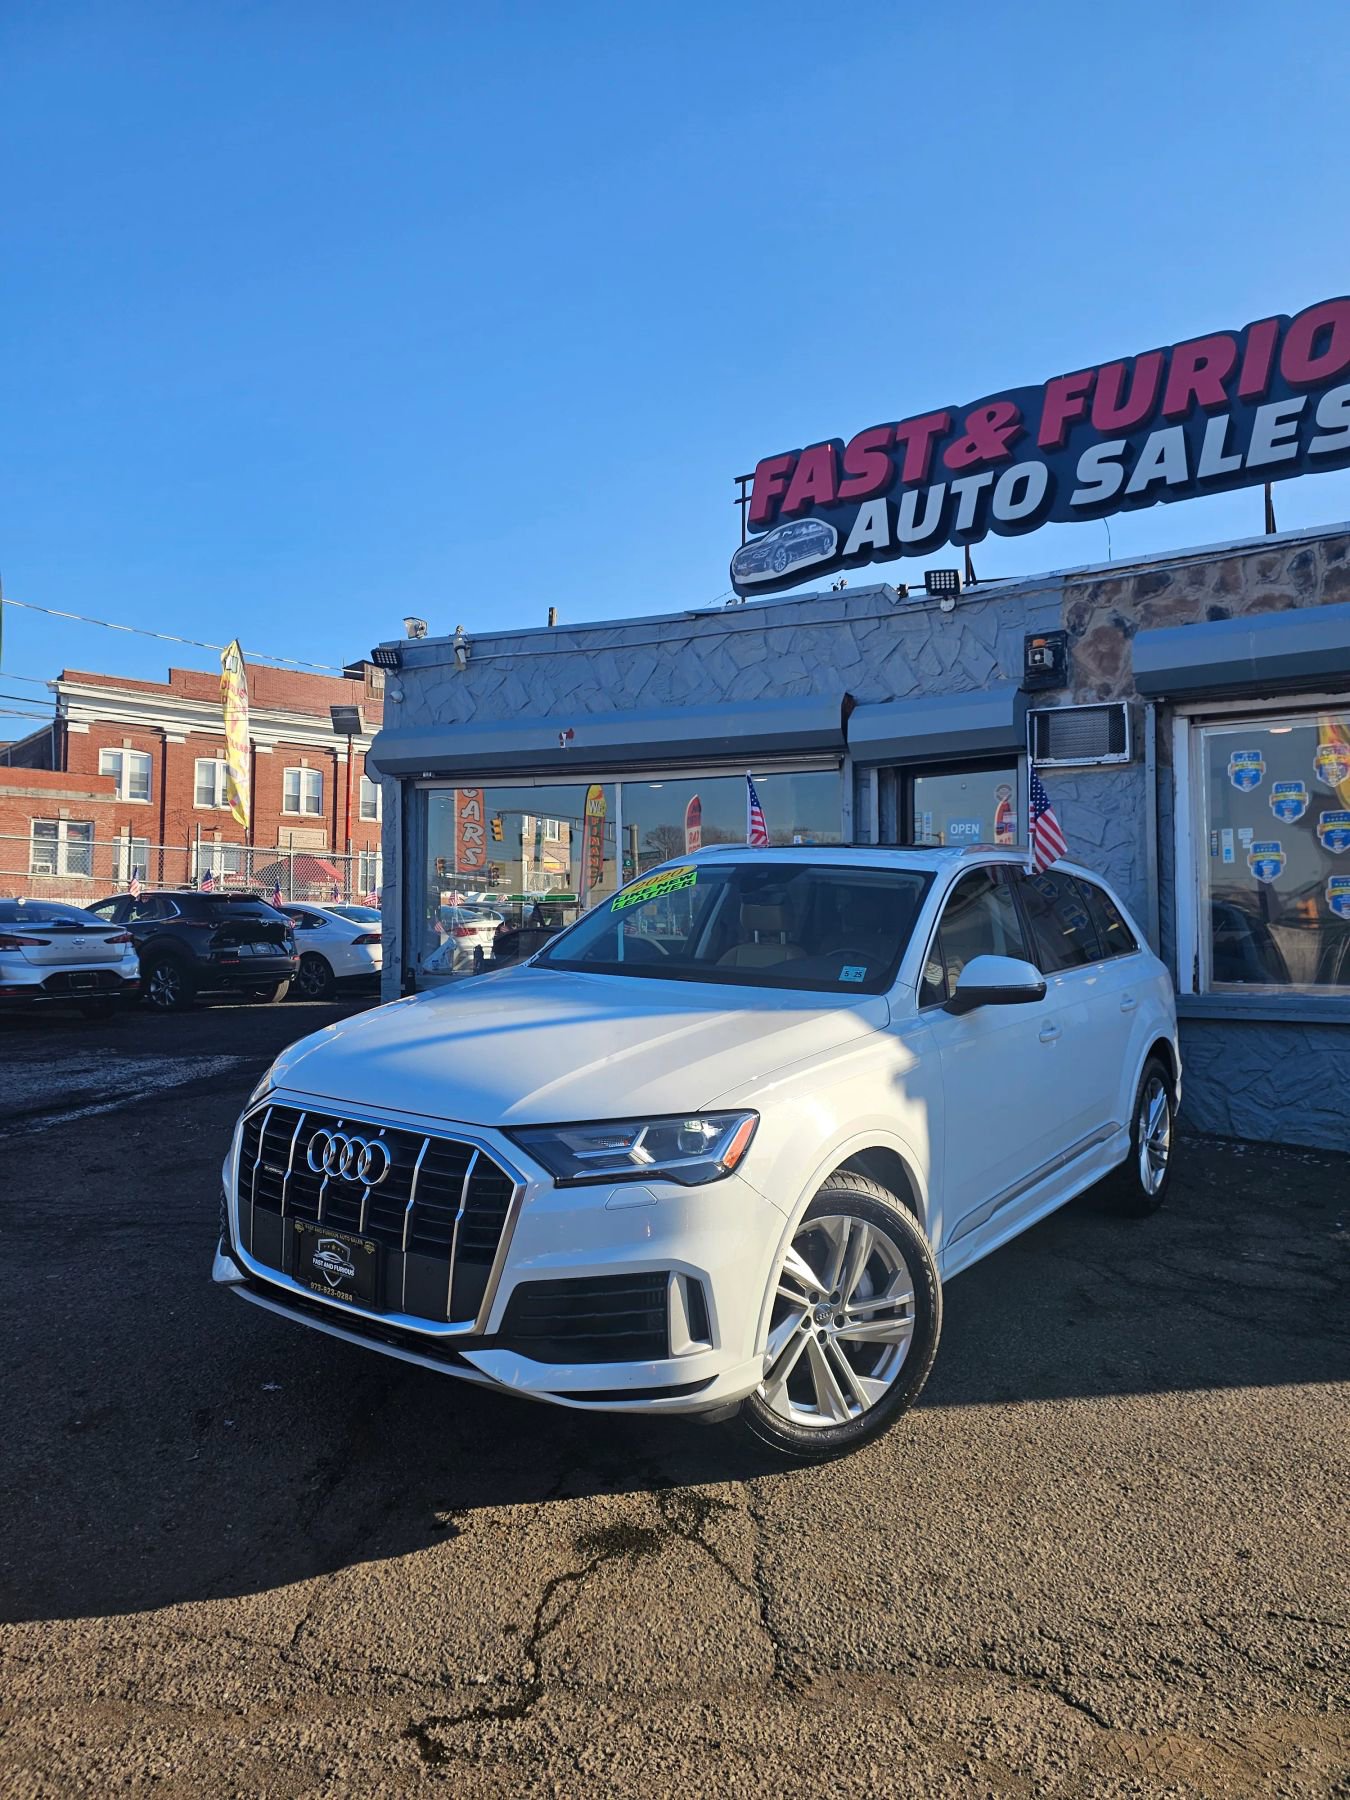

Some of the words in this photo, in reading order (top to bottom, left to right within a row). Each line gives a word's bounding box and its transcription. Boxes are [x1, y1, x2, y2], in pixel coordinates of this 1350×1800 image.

[748, 412, 951, 524] FAST
[943, 402, 1024, 470] &
[1038, 297, 1350, 449] FURIO
[842, 460, 1049, 555] AUTO
[1069, 383, 1350, 508] SALES
[950, 823, 980, 835] OPEN
[612, 879, 694, 911] LEATHER
[614, 886, 652, 904] LIKE
[656, 873, 694, 889] NEW
[632, 868, 685, 892] 2020
[312, 1257, 324, 1267] FAST
[323, 1261, 333, 1270] AND
[333, 1264, 355, 1277] FURIOUS
